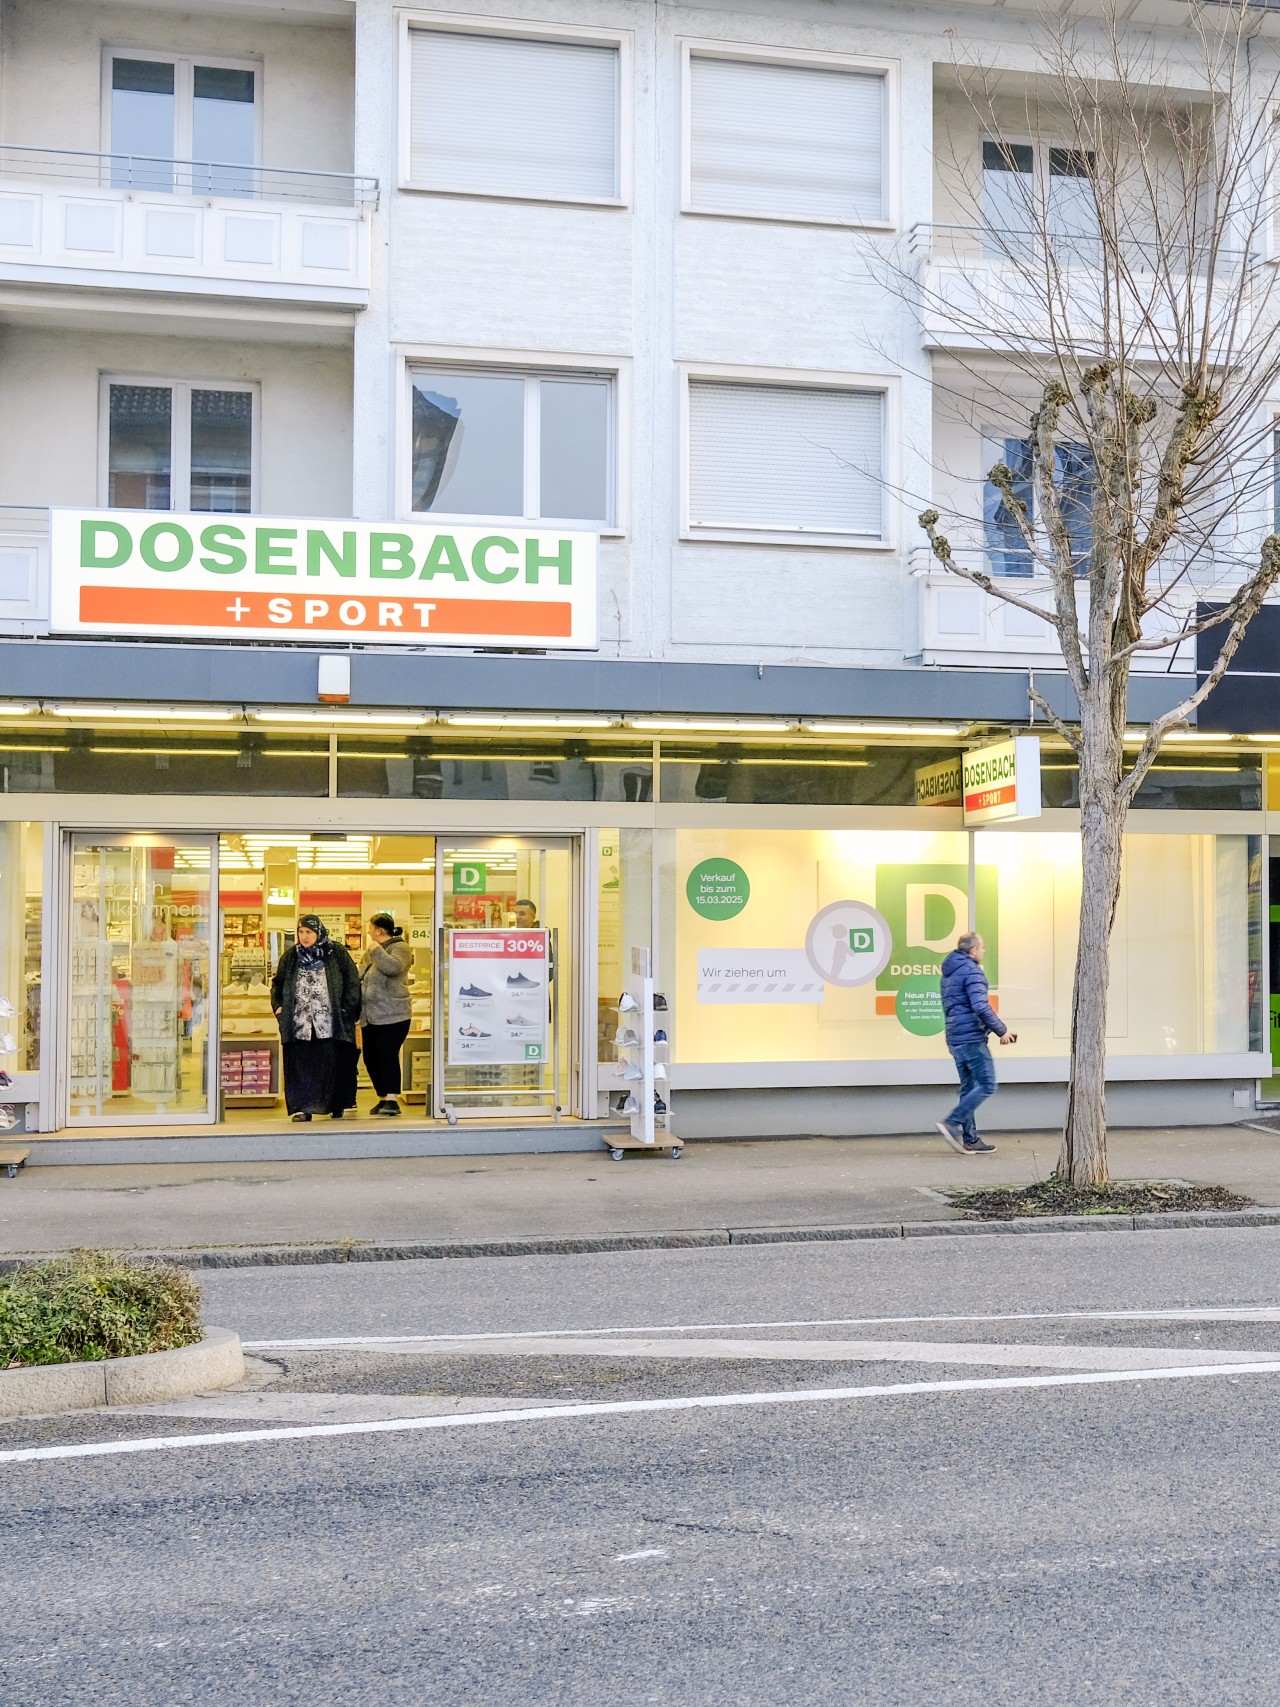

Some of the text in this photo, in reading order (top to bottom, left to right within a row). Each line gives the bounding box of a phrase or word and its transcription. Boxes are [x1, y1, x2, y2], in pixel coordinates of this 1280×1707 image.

[80, 519, 573, 586] DOSENBACH
[226, 597, 437, 629] + SPORT
[964, 754, 1016, 789] DOSENBACH
[982, 791, 1001, 806] SPORT
[700, 873, 736, 882] Verkauf
[700, 884, 736, 893] bis zum
[695, 895, 743, 904] 15.03.2025
[507, 939, 544, 953] 30%
[702, 967, 786, 978] Wir ziehen um
[926, 991, 942, 999] Filia
